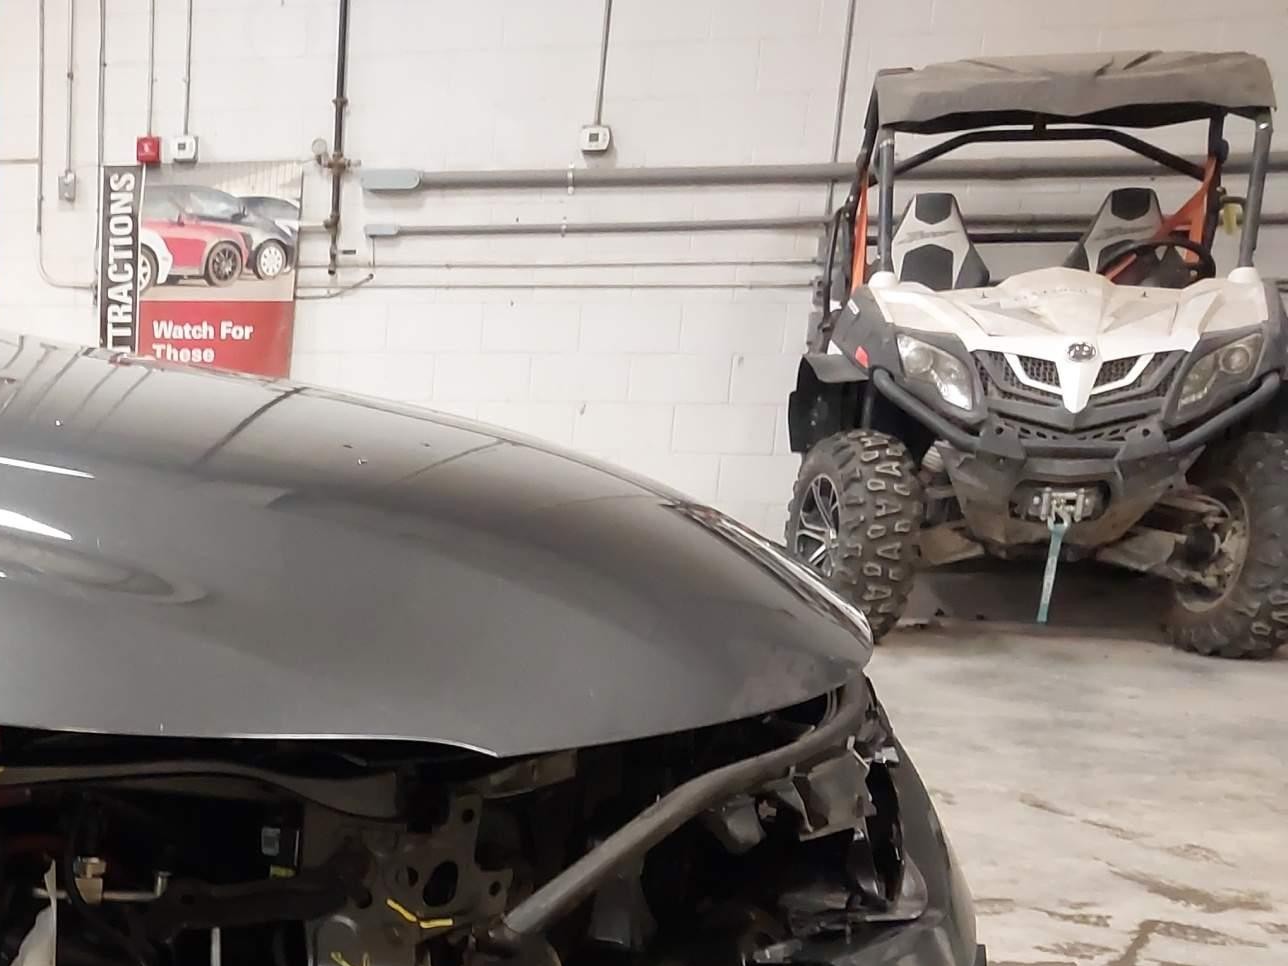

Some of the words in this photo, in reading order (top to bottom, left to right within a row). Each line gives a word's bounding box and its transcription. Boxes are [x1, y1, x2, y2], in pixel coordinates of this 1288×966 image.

[152, 320, 215, 340] Watch
[220, 320, 254, 340] For
[152, 343, 215, 363] These
